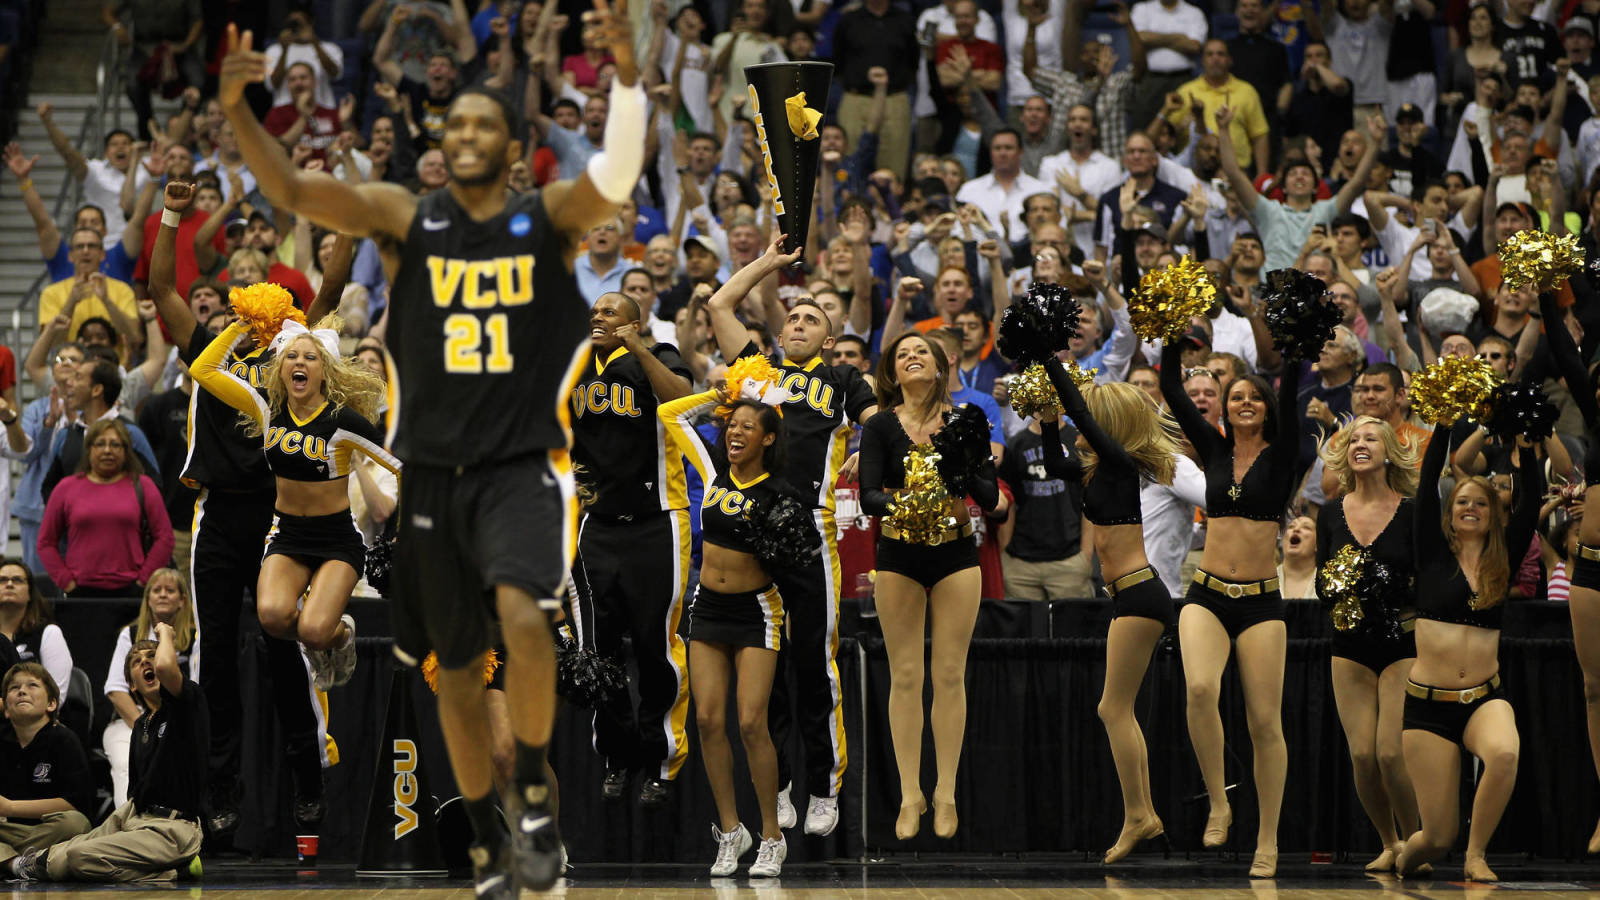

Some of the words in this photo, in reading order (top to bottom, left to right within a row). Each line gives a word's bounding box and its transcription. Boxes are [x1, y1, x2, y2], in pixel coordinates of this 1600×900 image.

[426, 254, 535, 310] VCU
[443, 313, 514, 374] 21
[222, 361, 272, 388] CU
[571, 381, 642, 420] VCU
[264, 426, 330, 462] VCU
[393, 739, 418, 841] VCU
